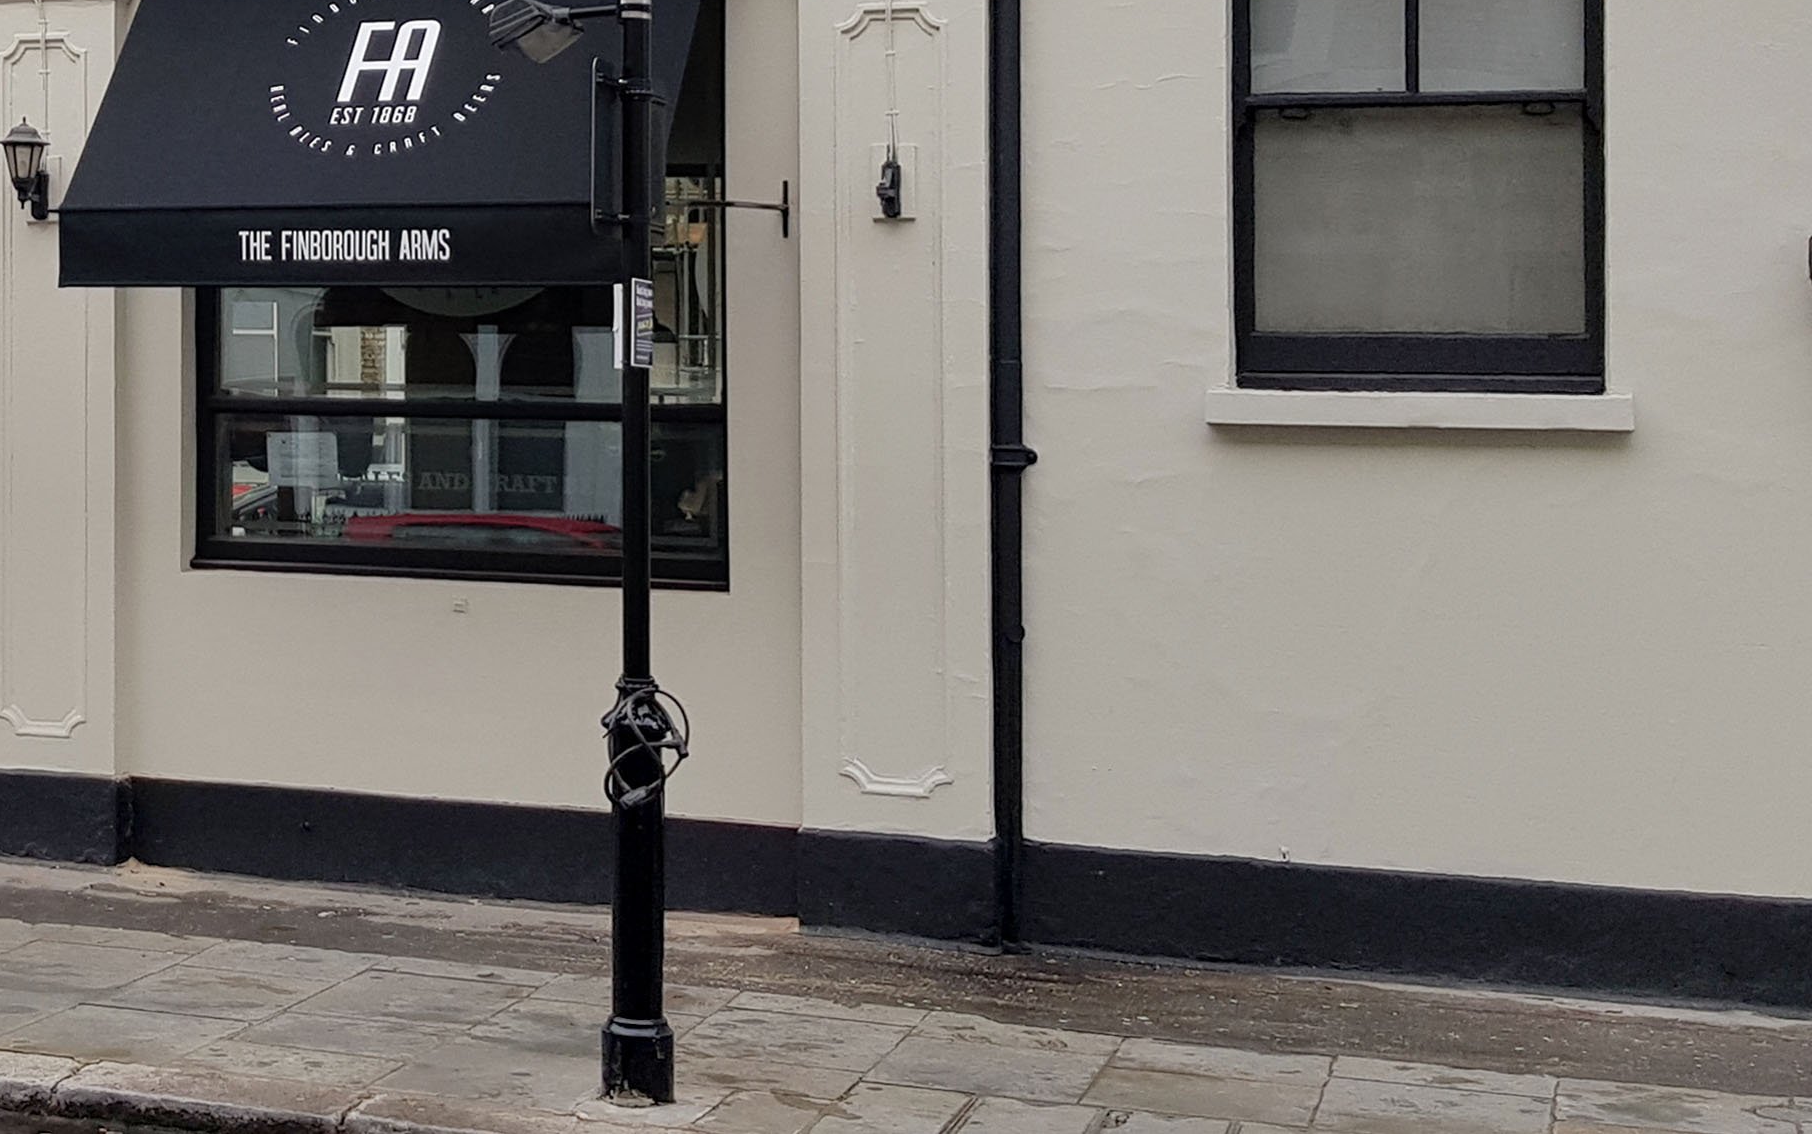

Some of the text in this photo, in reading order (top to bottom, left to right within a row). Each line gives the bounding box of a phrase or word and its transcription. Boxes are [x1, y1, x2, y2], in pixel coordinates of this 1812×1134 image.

[337, 19, 441, 102] FA
[270, 73, 501, 156] REAL ALES & CRAFT BEERS
[329, 106, 418, 125] EST 1868
[238, 229, 451, 261] THE FINBOROUGH ARMS
[418, 471, 470, 490] AND
